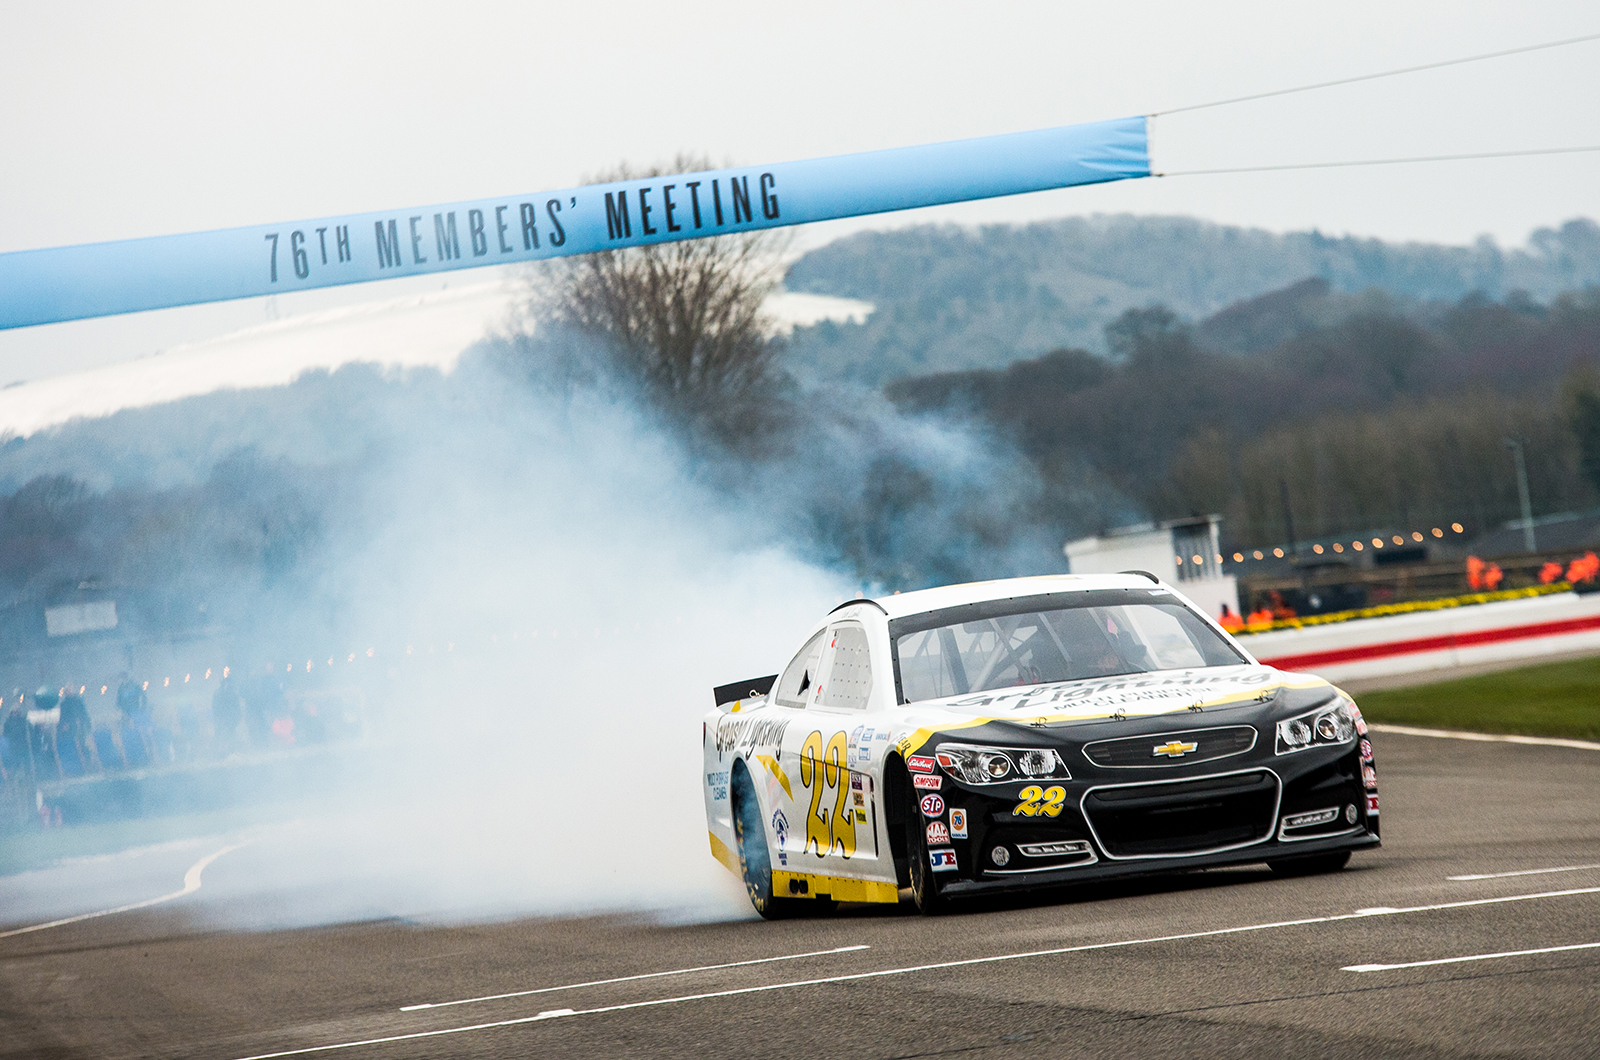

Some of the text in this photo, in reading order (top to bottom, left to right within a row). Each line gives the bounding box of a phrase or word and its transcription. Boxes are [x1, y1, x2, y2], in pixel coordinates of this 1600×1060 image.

[265, 225, 352, 283] 76TH
[605, 172, 780, 240] MEETING
[914, 776, 940, 788] SIMPSON
[800, 730, 857, 860] 22
[923, 797, 942, 813] STP
[1012, 785, 1067, 818] 22
[953, 815, 963, 826] 76
